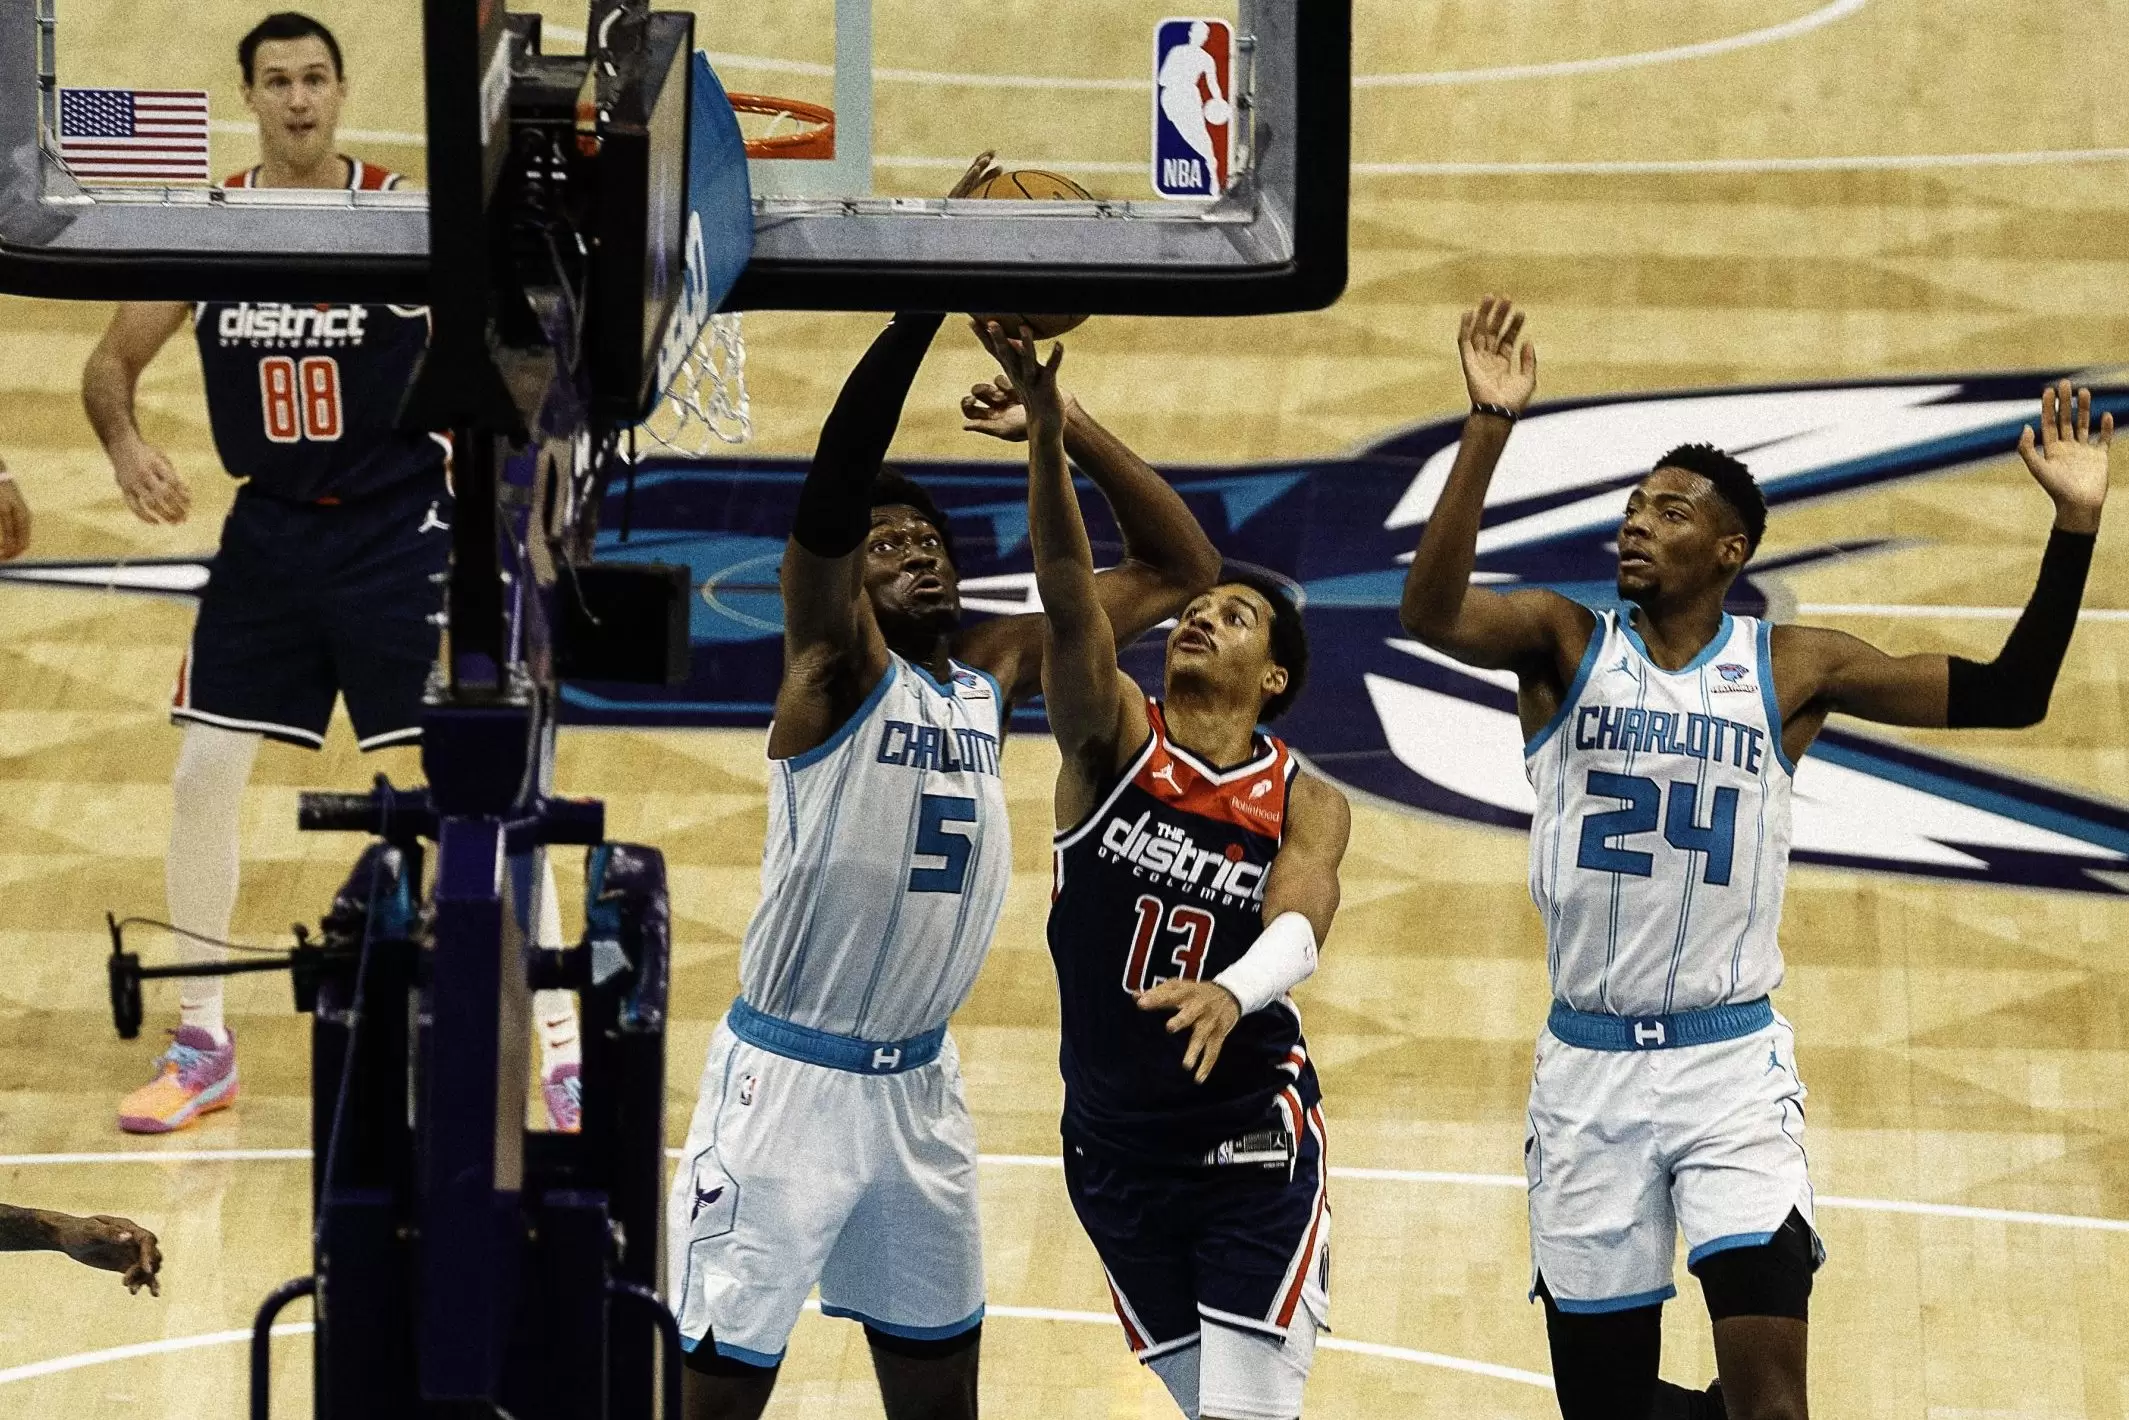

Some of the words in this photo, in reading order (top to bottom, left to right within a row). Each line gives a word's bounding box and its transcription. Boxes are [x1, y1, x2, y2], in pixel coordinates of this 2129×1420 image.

[1163, 158, 1203, 189] NBA
[219, 302, 368, 338] district
[259, 356, 344, 443] 88
[1576, 705, 1765, 776] CHARLOTTE
[908, 793, 976, 894] 5
[1157, 822, 1185, 843] THE
[1577, 770, 1740, 887] 24
[1122, 894, 1215, 994] 13
